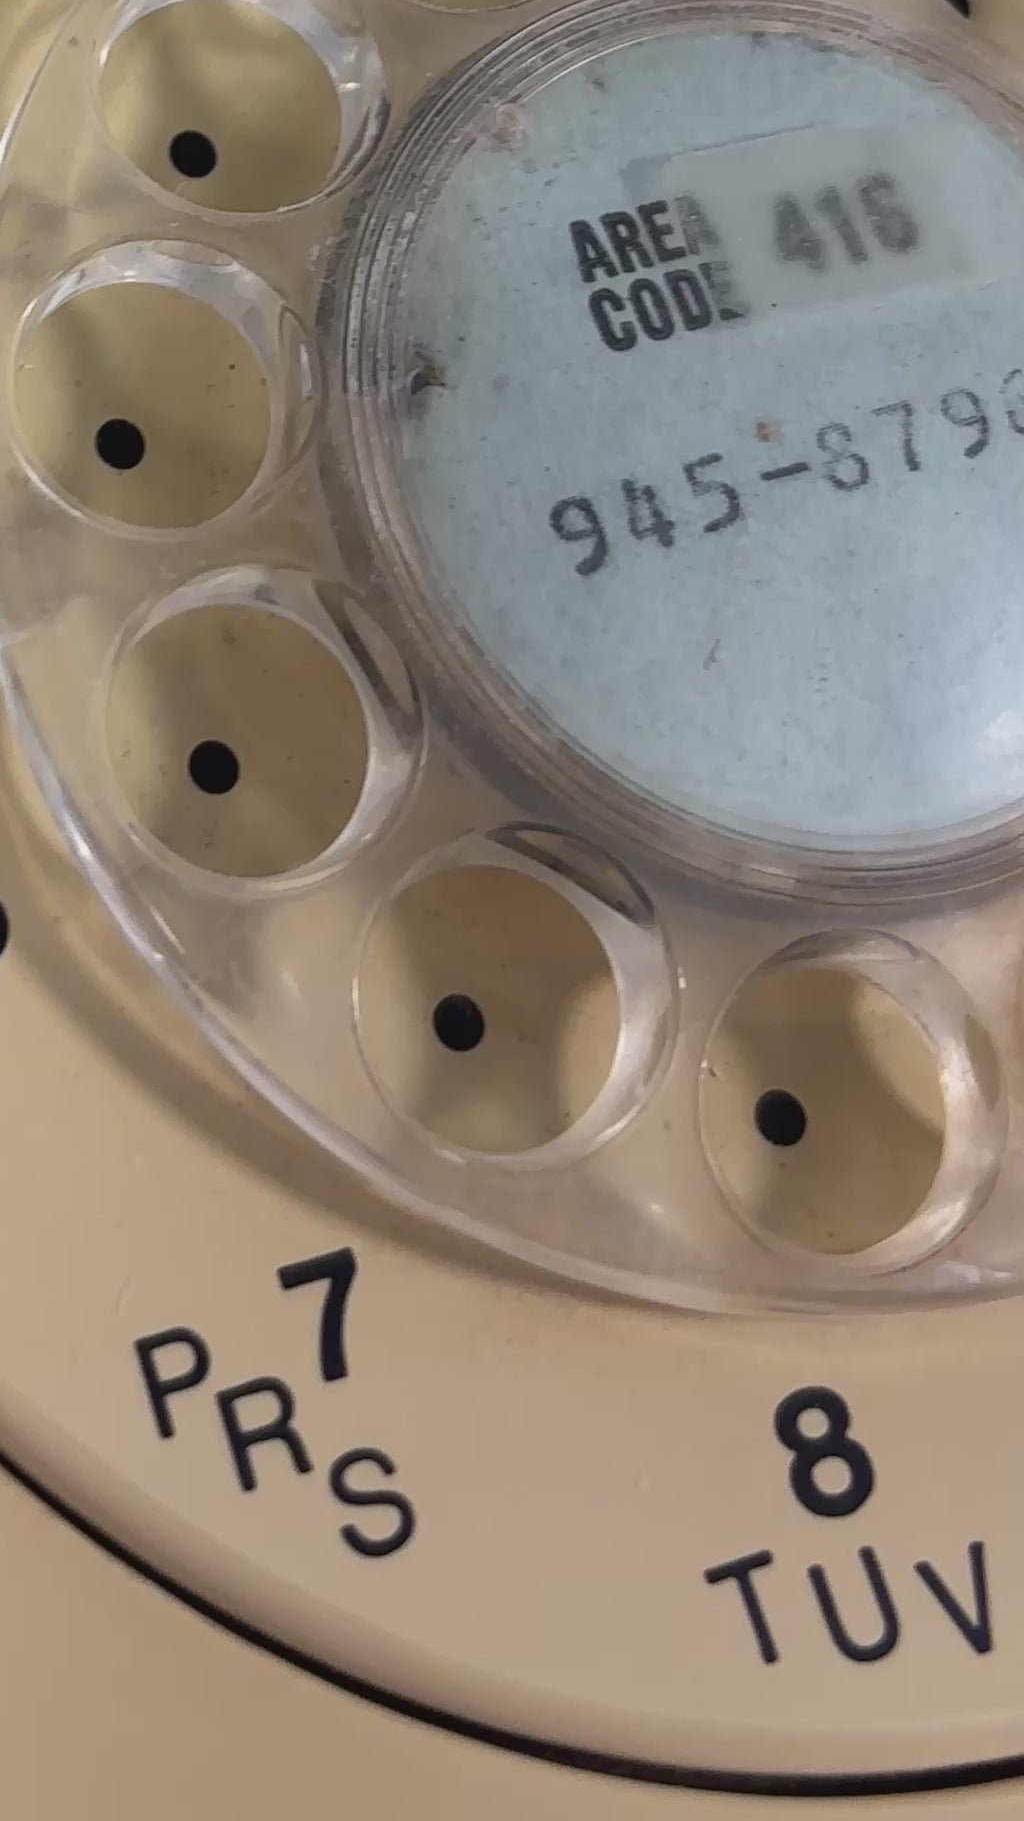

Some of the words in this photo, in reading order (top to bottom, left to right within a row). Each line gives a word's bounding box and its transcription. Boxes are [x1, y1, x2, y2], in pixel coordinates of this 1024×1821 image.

[567, 194, 722, 285] AREA
[586, 260, 748, 354] CODE
[276, 1246, 359, 1385] 7
[773, 1385, 876, 1520] 8
[702, 1540, 994, 1666] TUV
